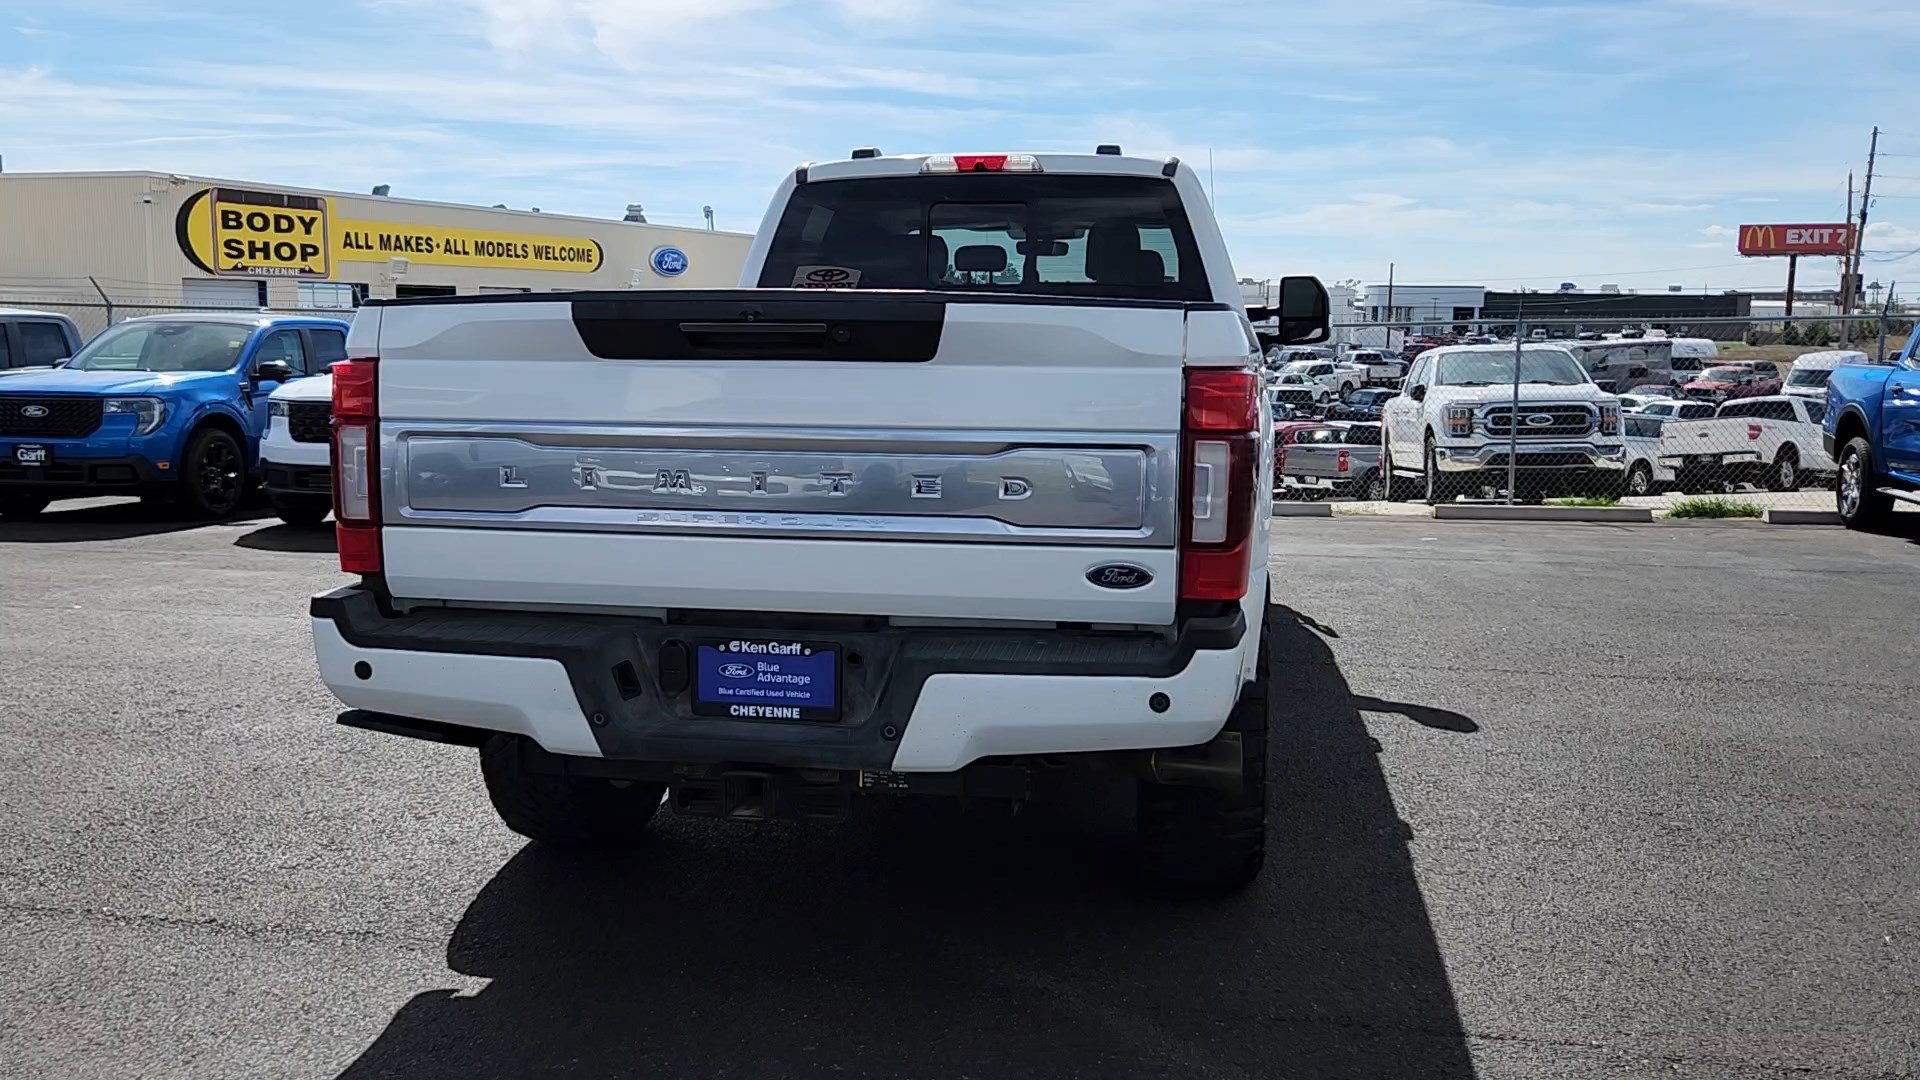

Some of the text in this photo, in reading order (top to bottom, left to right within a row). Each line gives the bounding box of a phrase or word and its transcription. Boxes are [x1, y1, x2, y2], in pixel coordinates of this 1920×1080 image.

[220, 209, 319, 235] BODY
[1786, 228, 1833, 245] EXIT
[223, 238, 320, 262] SHOP
[342, 231, 593, 263] ALL MAKES ALL MODELS WELCOME
[662, 253, 683, 269] Ford
[248, 266, 301, 276] CHEYENNE
[17, 448, 47, 461] Garff
[499, 464, 1033, 500] LIMITED
[1101, 567, 1138, 583] Ford
[741, 641, 802, 655] Ken Garff
[725, 665, 748, 676] Ford
[757, 661, 780, 672] Blue
[757, 673, 811, 685] Advantage
[718, 687, 811, 699] Blue Certified Used Vehicle
[730, 705, 801, 719] CHEYENNE
